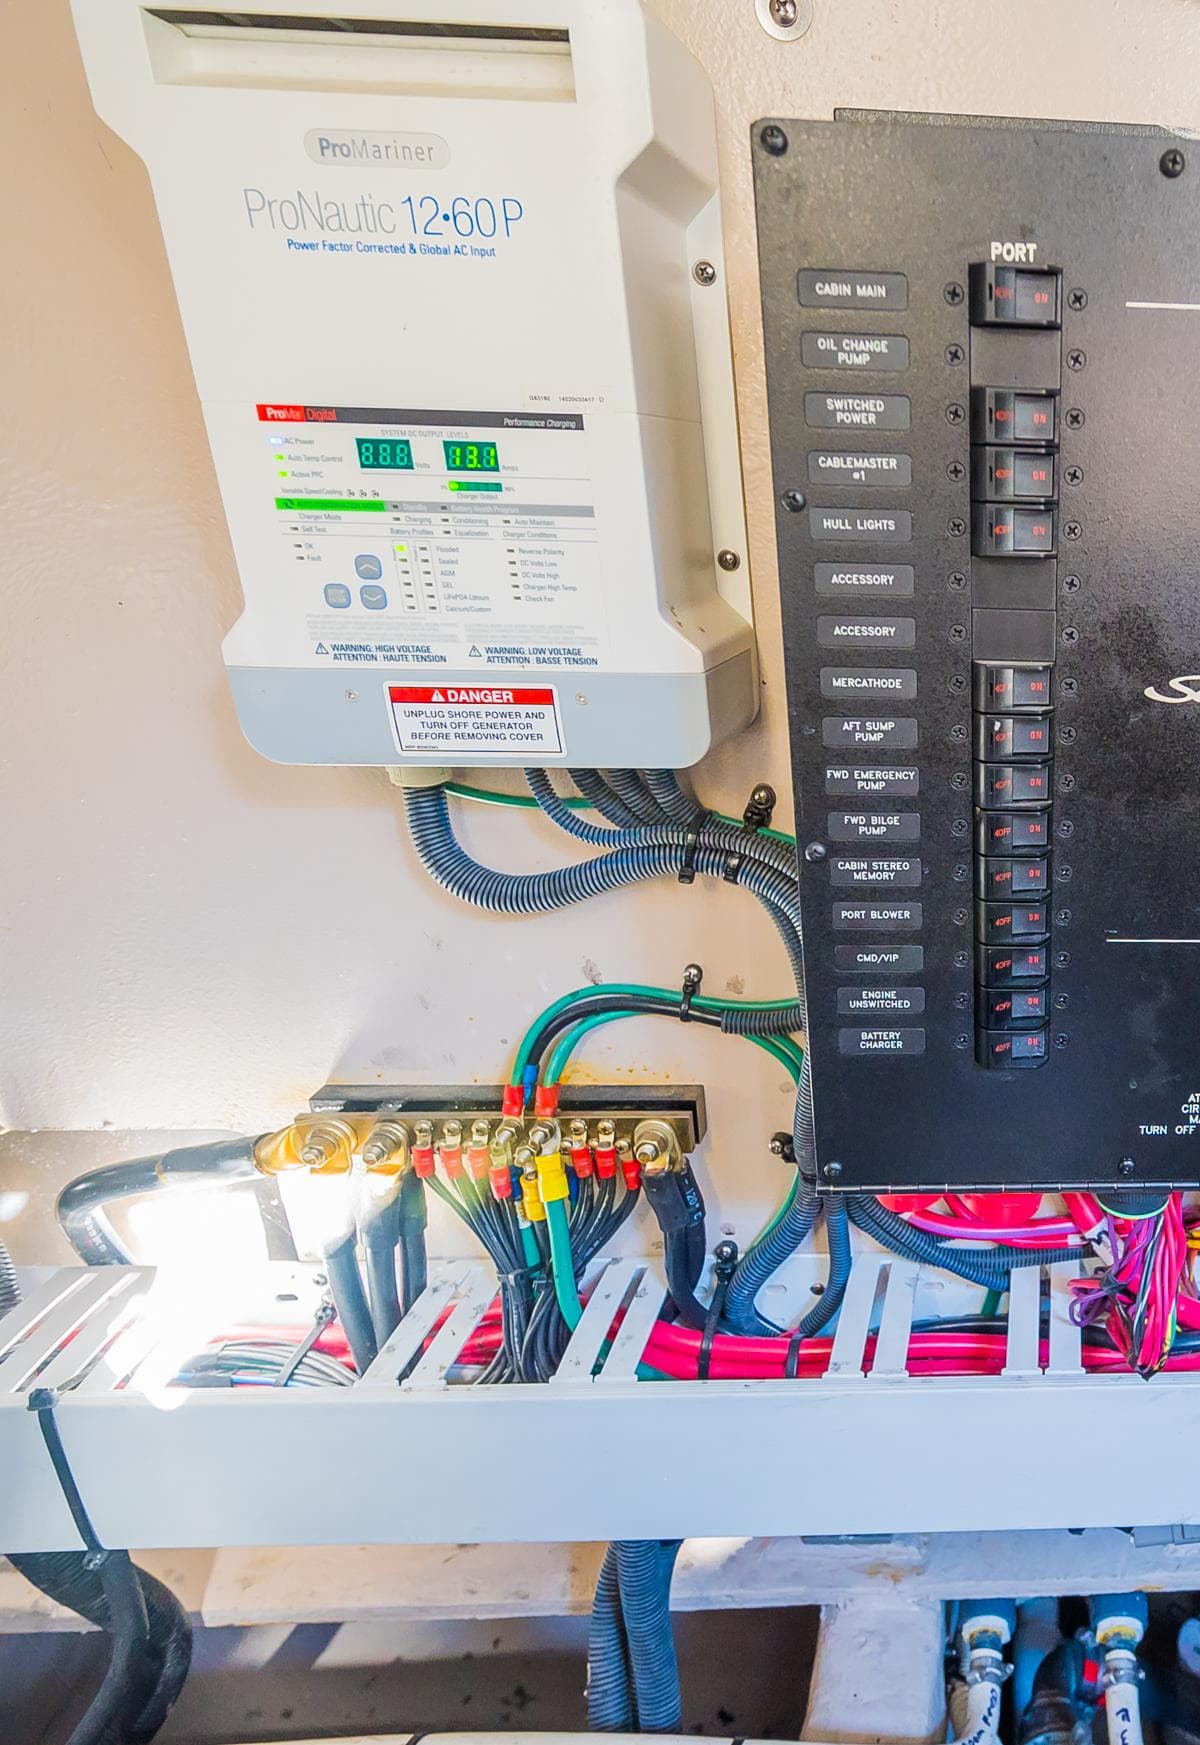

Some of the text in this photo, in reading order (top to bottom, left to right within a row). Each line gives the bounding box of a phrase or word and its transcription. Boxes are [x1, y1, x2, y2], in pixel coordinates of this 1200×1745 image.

[317, 137, 435, 163] ProMariner
[244, 188, 396, 234] ProNautic
[287, 239, 496, 259] Power Factor Corrected & Global AC Input
[991, 242, 1037, 262] PORT
[816, 283, 886, 298] CABIN MAIN
[818, 338, 888, 353] OIL CHANGE
[838, 352, 871, 364] PUMP
[826, 399, 884, 412] SWITCHED
[267, 408, 576, 429] ProMar Digital Performance Charging
[837, 412, 876, 424] POWER
[446, 431, 469, 439] LEVELS
[303, 455, 321, 463] Temp
[819, 457, 897, 469] CABLEMASTER
[823, 518, 895, 530] HULL LIGHTS
[832, 575, 894, 585] ACCESSORY
[834, 627, 896, 636] ACCESSORY
[374, 645, 393, 653] HIGH
[396, 645, 431, 654] VOLTAGE
[528, 648, 546, 656] LOW
[548, 648, 582, 657] VOLTAGE
[382, 655, 409, 663] HAUTE
[411, 655, 447, 663] TENSION
[536, 657, 561, 665] BASSE
[563, 657, 598, 666] TENSION
[833, 678, 902, 688] MERCATHODE
[448, 690, 513, 703] DANGER
[404, 710, 545, 720] UNPLUG SHORE POWER AND
[420, 721, 532, 730] TURN OFF GENERATOR
[843, 722, 894, 731] AFT SUMP
[411, 732, 543, 741] BEFORE REMOVING COVER
[855, 732, 883, 741] PUMP
[827, 770, 914, 780] FWD EMERGENCY
[858, 781, 885, 790] PUMP
[844, 816, 899, 825] FWD BILGE
[859, 826, 886, 835] PUMP
[838, 862, 909, 871] CABIN STEREO
[854, 871, 895, 880] MEMORY
[841, 911, 910, 919] PORT BLOWER
[857, 954, 899, 963] CMD/VIP
[862, 991, 897, 999] ENGINE
[850, 1000, 910, 1009] UNSWITCHED
[861, 1032, 901, 1040] BATTERY
[860, 1040, 902, 1049] CHARGER
[1139, 1125, 1167, 1135] TURN
[1176, 1125, 1195, 1134] OFF
